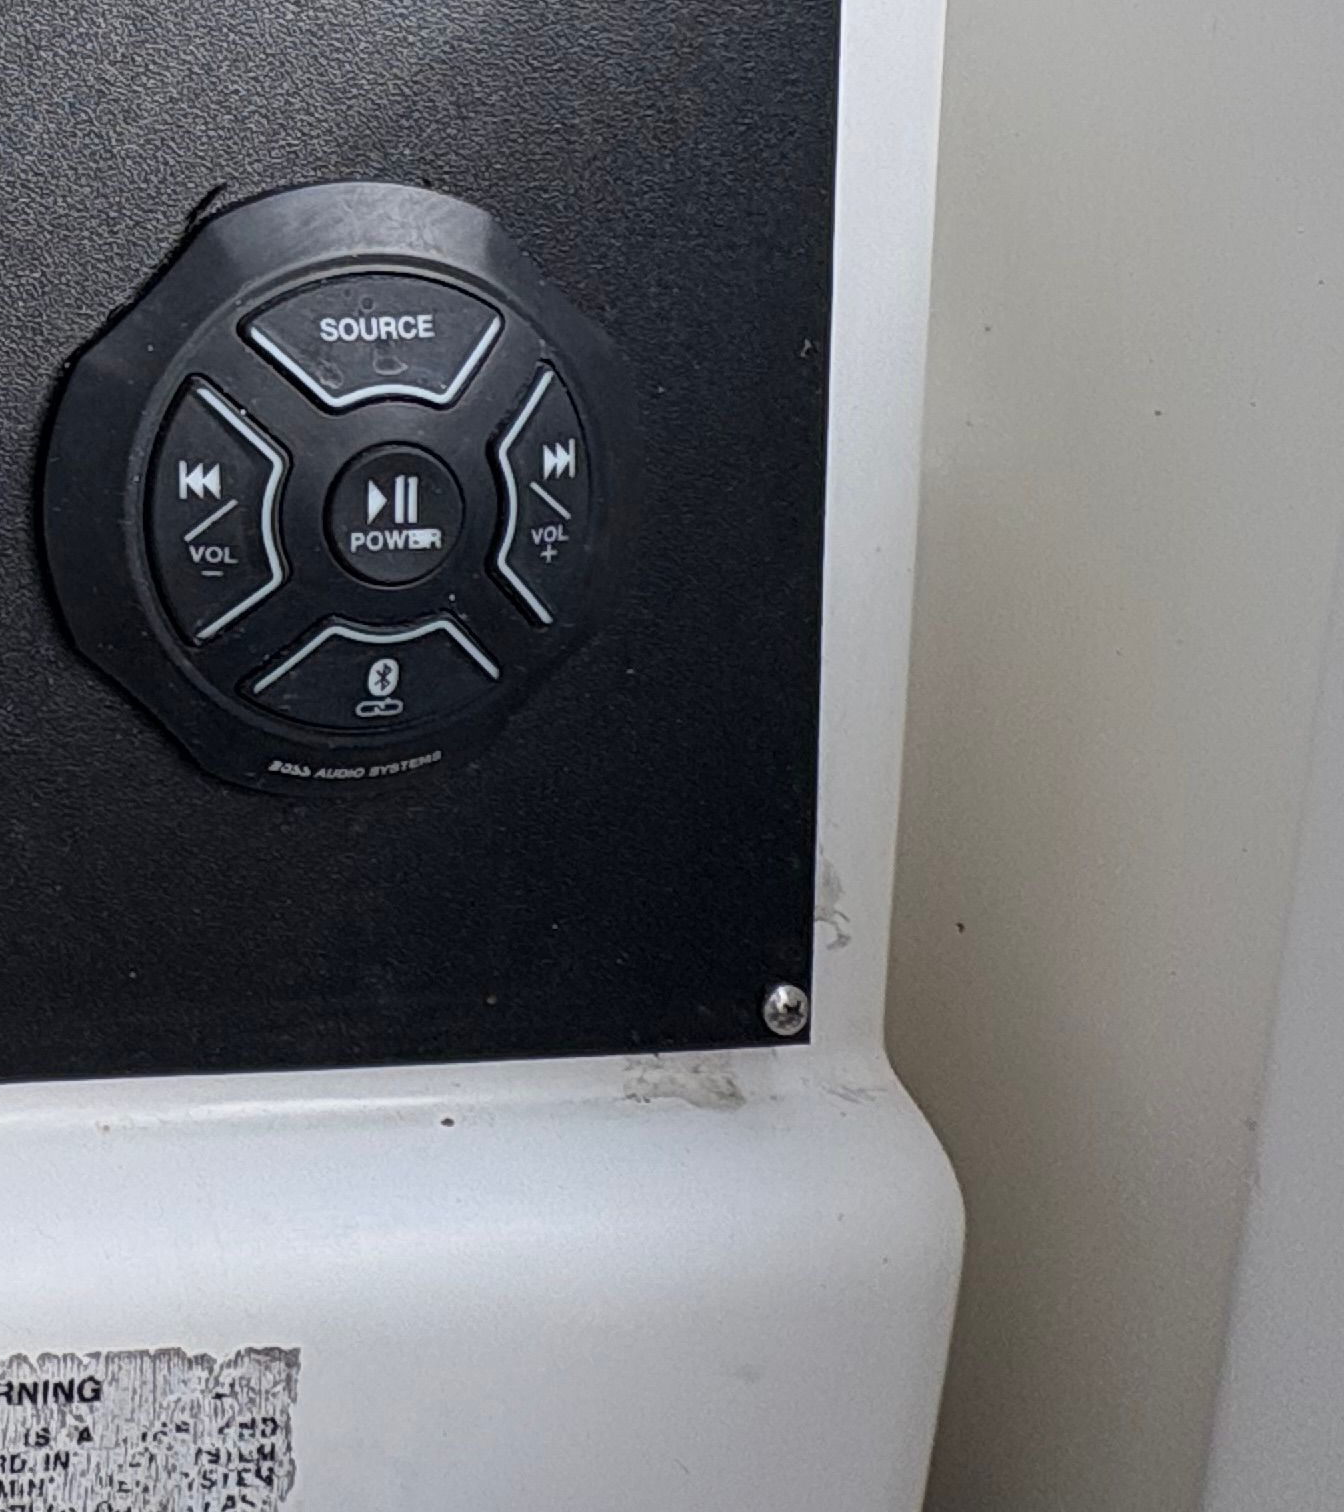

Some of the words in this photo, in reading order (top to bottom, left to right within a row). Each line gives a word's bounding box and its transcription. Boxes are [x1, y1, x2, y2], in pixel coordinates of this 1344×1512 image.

[320, 315, 436, 341] SOURCE
[350, 528, 442, 553] POWER
[531, 524, 570, 544] VOL
[190, 545, 238, 564] VOL
[313, 767, 365, 779] AUDIO
